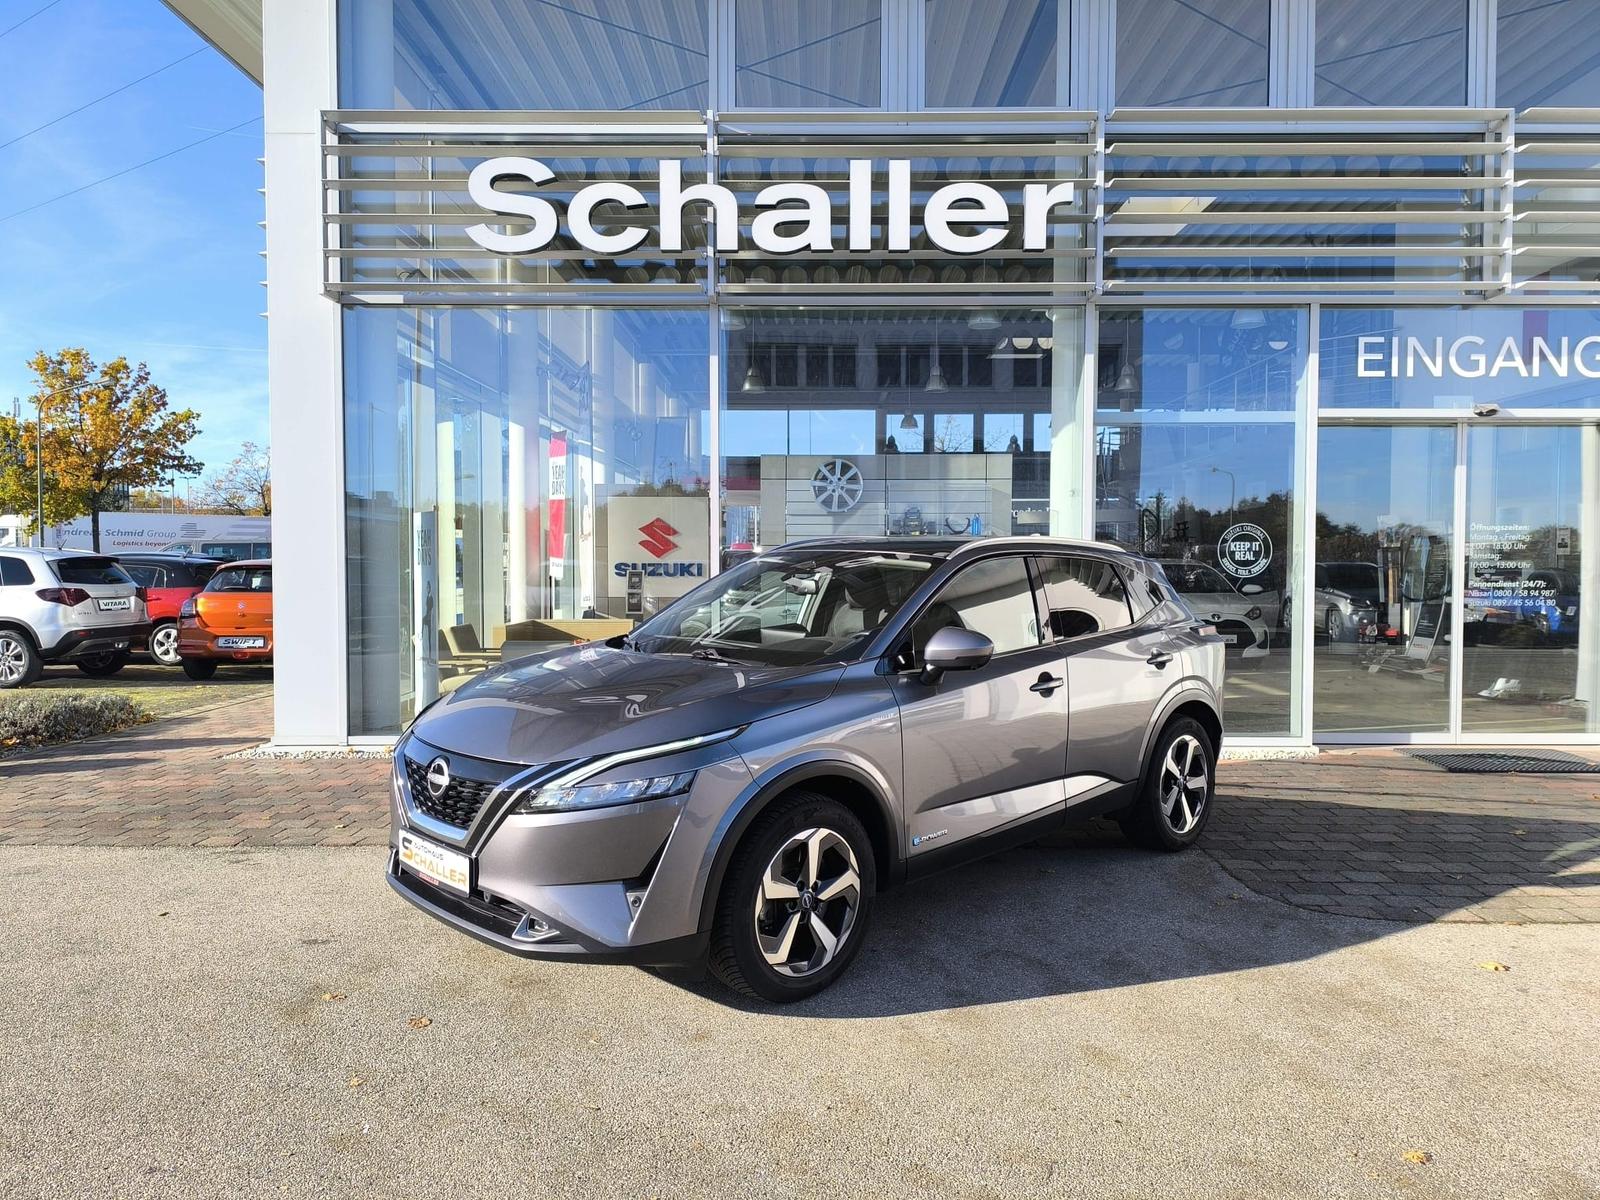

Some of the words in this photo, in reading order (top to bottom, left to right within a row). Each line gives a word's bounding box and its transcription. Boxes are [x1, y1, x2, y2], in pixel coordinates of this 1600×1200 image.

[464, 156, 1074, 254] Schaller
[1357, 335, 1600, 378] EINGANG
[105, 528, 145, 537] Schmid
[146, 529, 177, 539] Group
[1471, 533, 1498, 542] Montag
[1230, 541, 1250, 551] KEEP
[1252, 541, 1260, 551] IT
[1513, 542, 1528, 550] Uhr
[1235, 551, 1256, 561] REAL
[614, 562, 703, 577] SUZUKI
[1517, 561, 1532, 569] Uhr
[1468, 580, 1520, 588] Pannendienst
[1468, 589, 1492, 597] Nissan
[1493, 589, 1512, 597] 0800
[1519, 589, 1529, 597] 58
[1529, 589, 1539, 597] 94
[1540, 589, 1555, 597] 987
[102, 600, 127, 608] VITARA
[1467, 599, 1491, 607] Suzuki
[1492, 599, 1507, 607] 089
[1513, 599, 1523, 607] 45
[1524, 599, 1534, 607] 56
[1535, 599, 1545, 607] 04
[1545, 599, 1556, 607] 80
